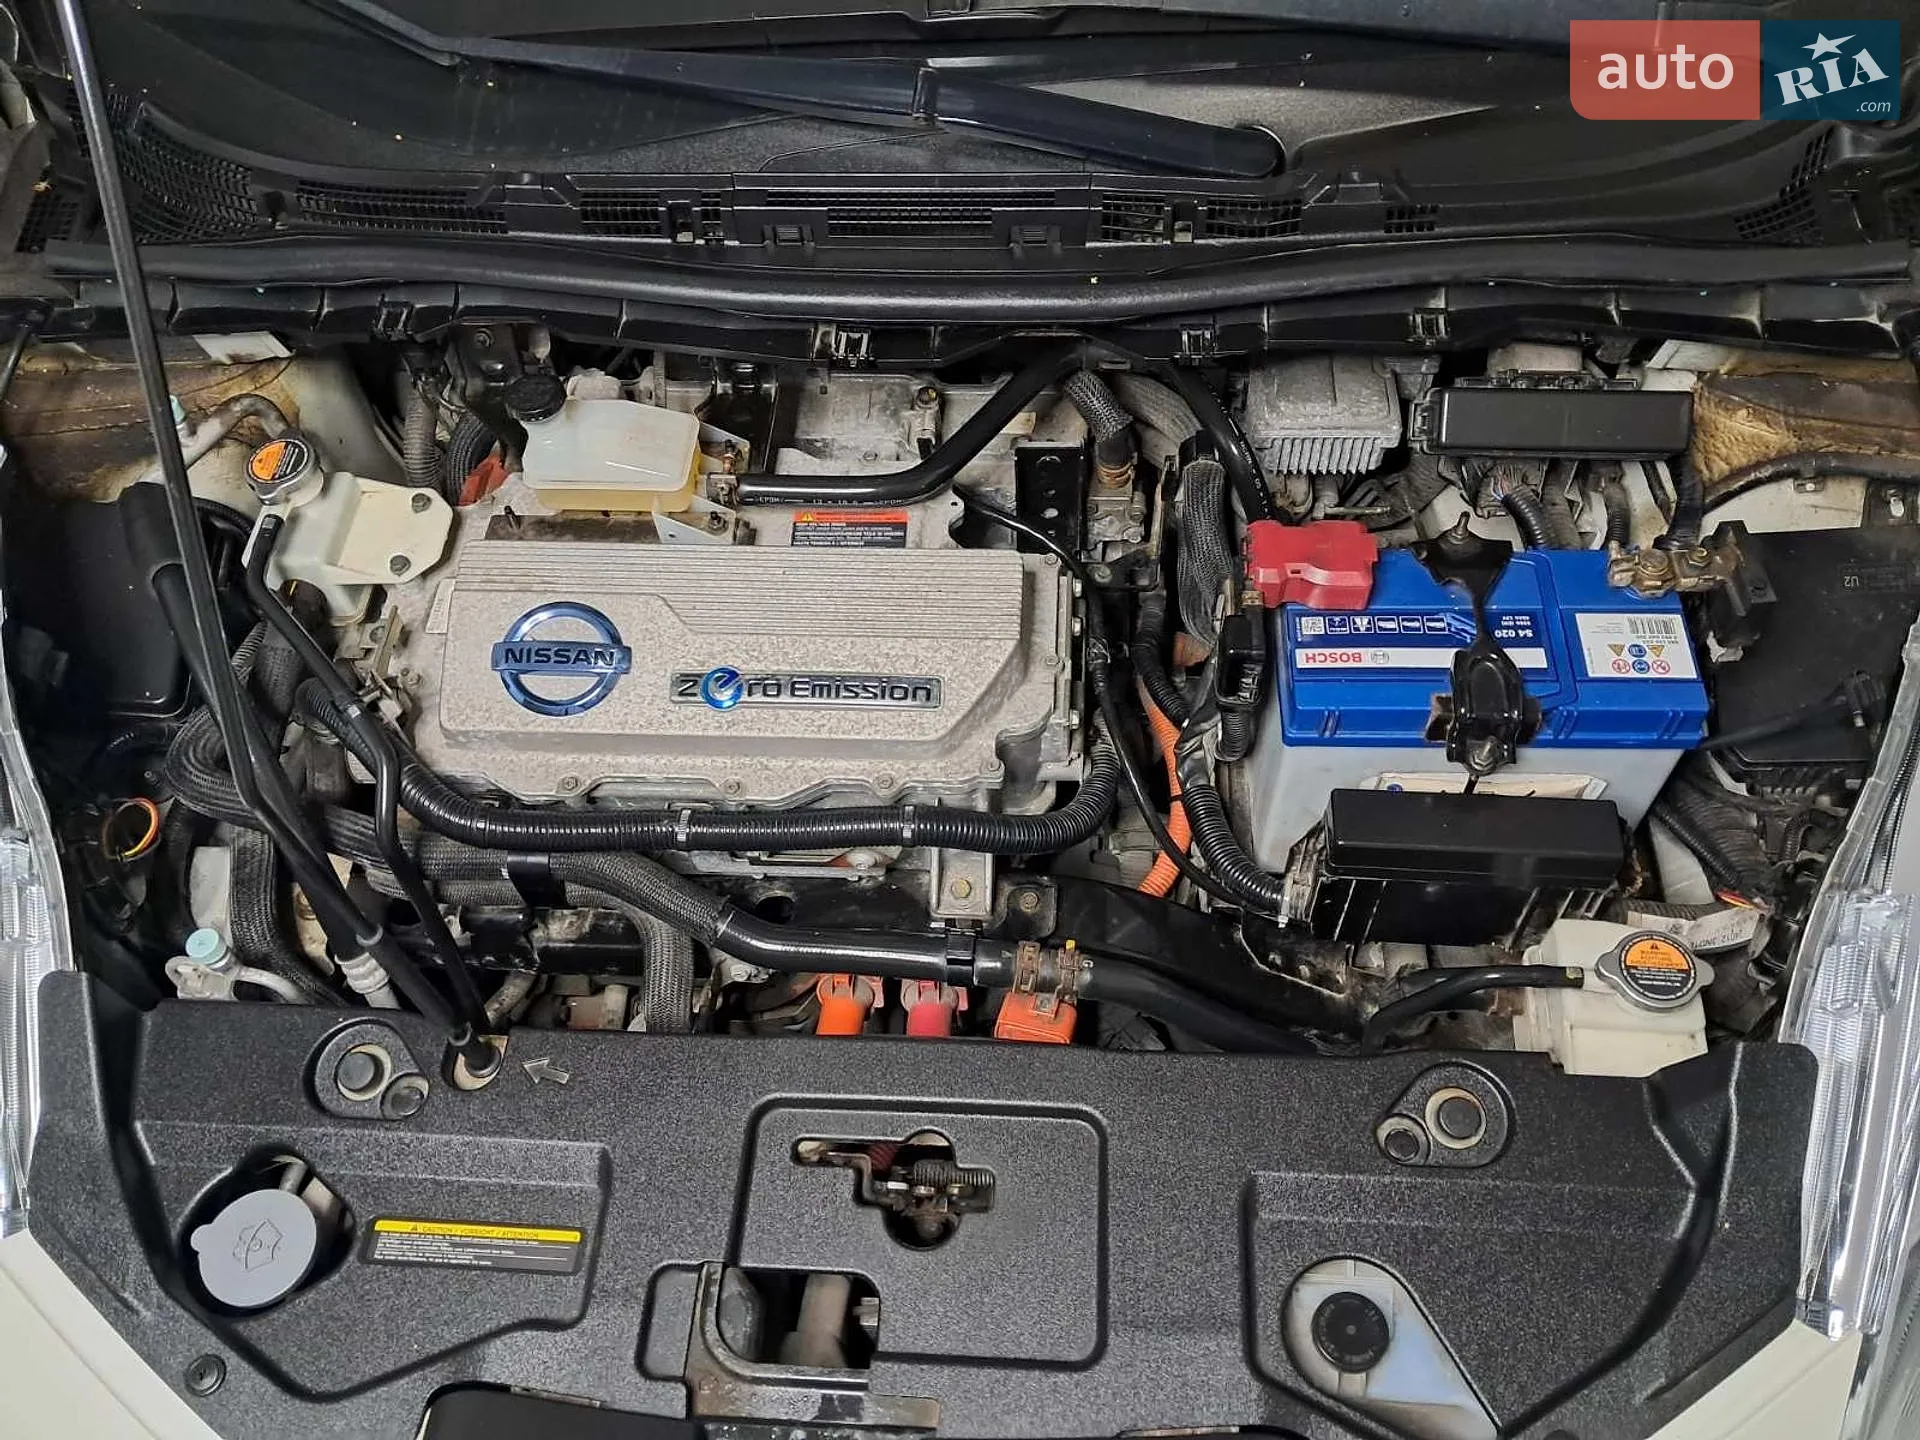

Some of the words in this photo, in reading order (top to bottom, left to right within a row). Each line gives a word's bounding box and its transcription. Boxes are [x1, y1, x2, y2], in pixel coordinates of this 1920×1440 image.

[1494, 628, 1516, 638] 020
[503, 647, 617, 667] NISSAN
[1305, 652, 1362, 664] BOSCH
